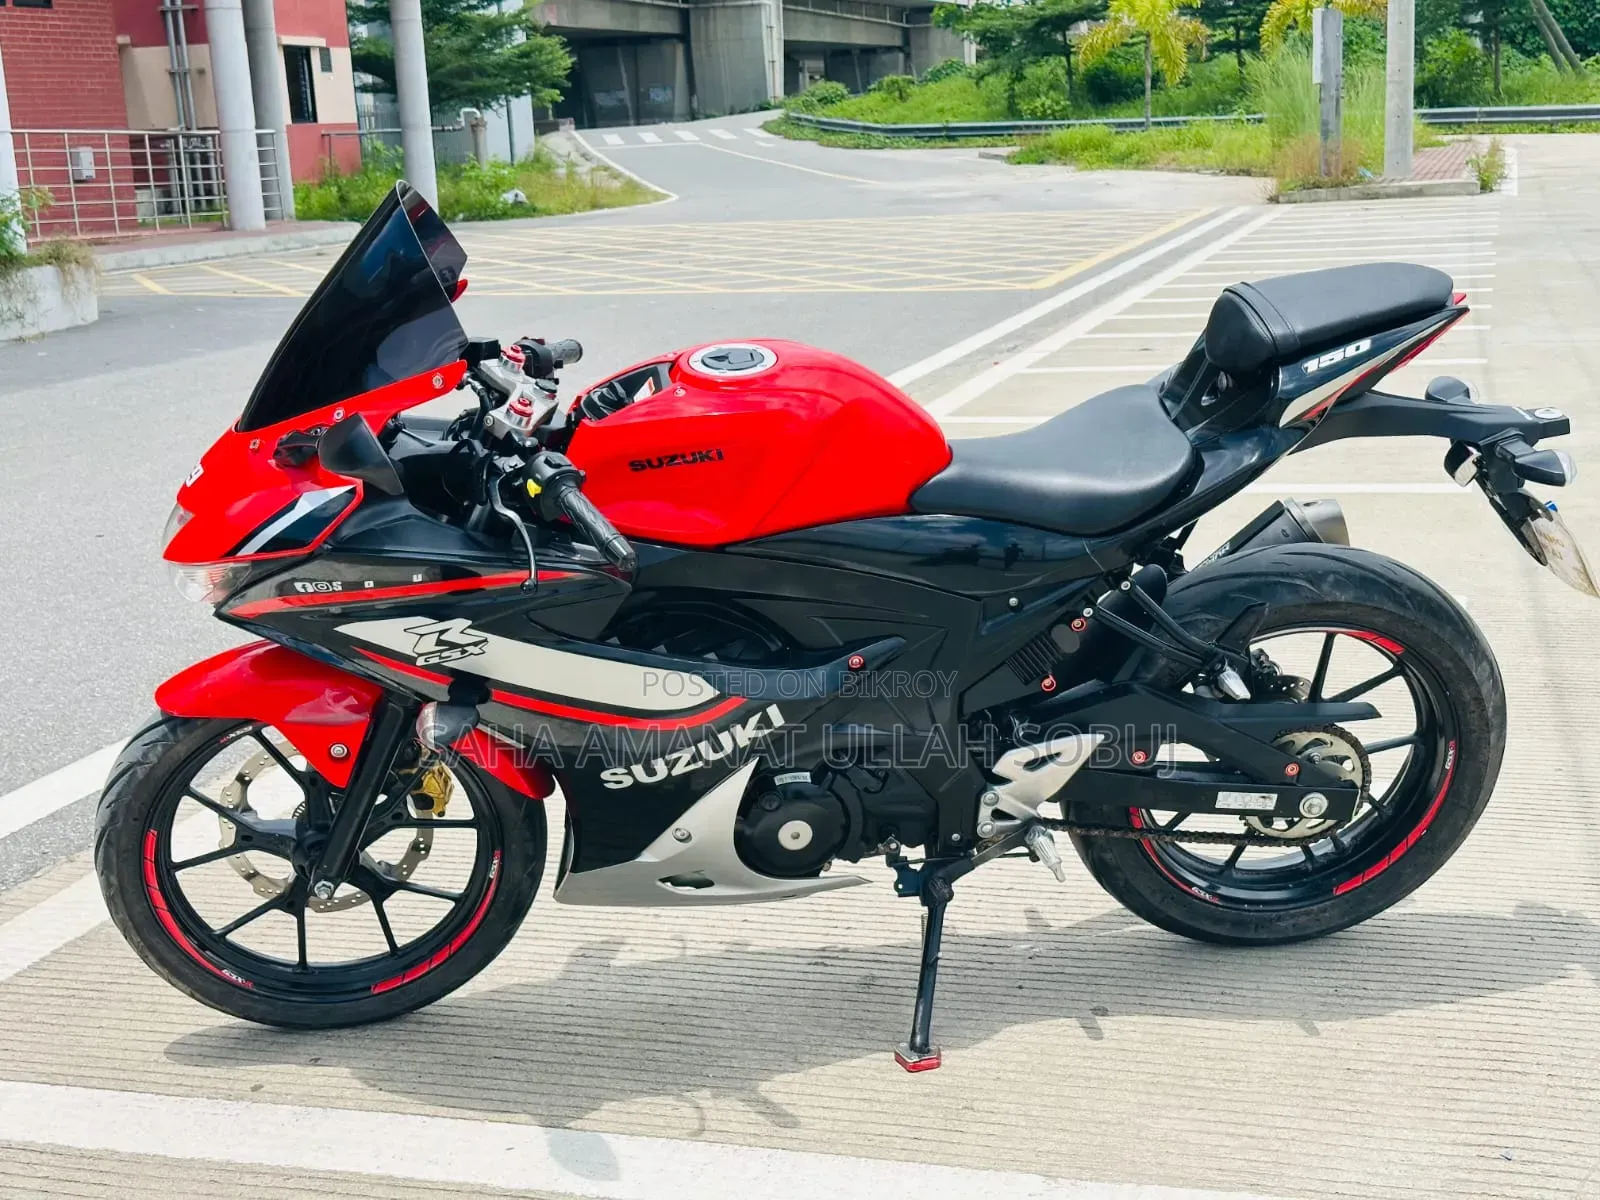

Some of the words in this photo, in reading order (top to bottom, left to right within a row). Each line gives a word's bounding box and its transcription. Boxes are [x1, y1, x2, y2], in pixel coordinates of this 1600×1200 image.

[1302, 339, 1371, 374] 150
[628, 448, 724, 472] SUZUKI
[601, 703, 786, 790] SUZUKI
